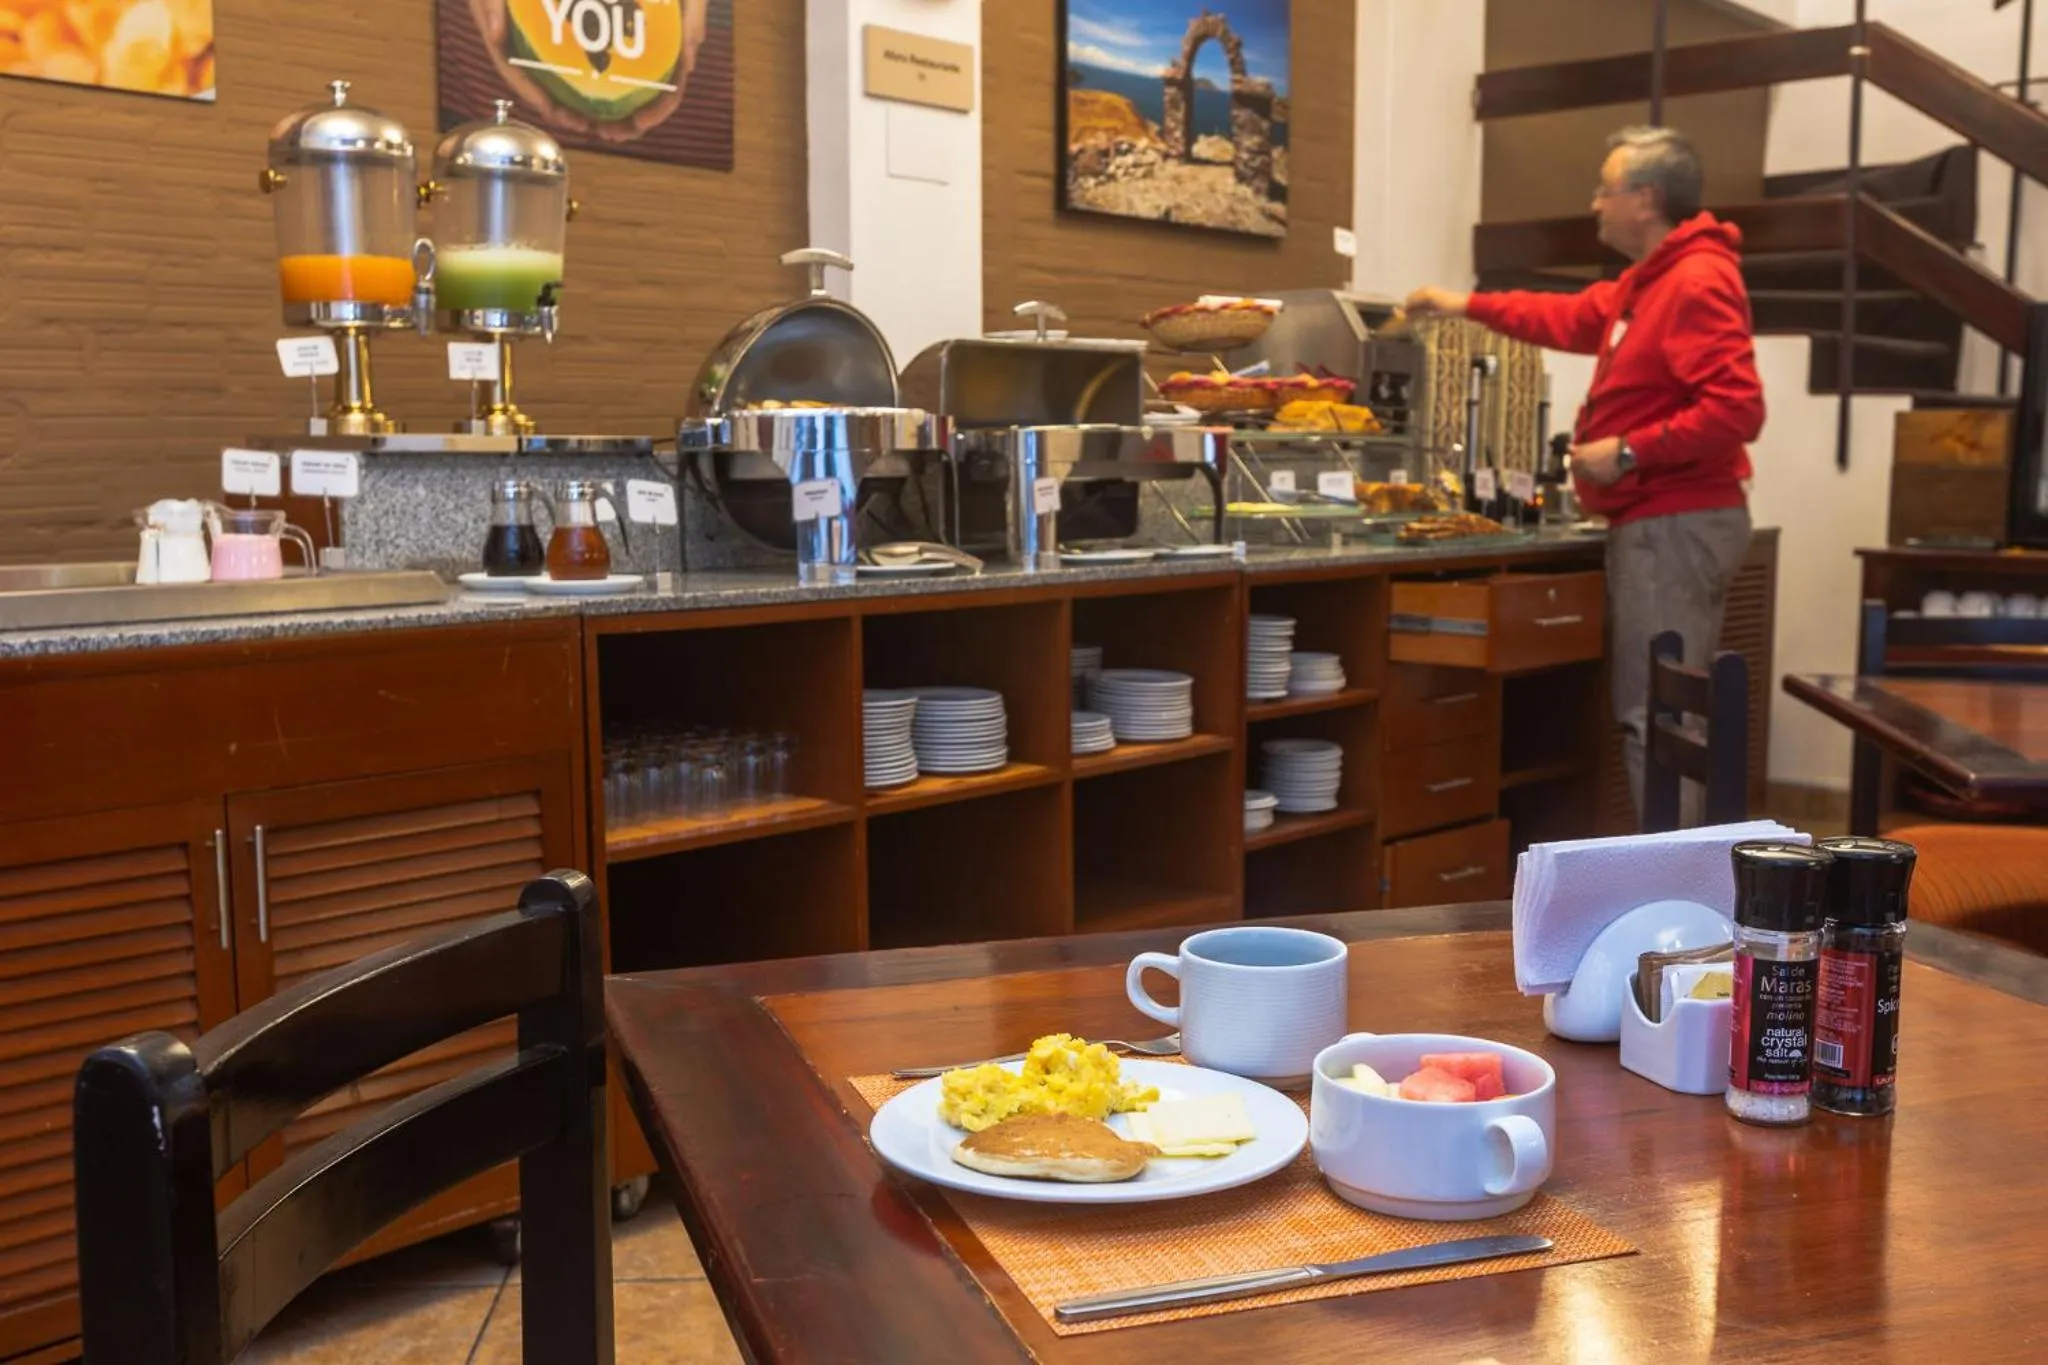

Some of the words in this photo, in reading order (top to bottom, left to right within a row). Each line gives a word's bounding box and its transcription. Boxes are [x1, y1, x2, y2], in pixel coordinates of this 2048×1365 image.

[540, 0, 645, 59] YOU
[1790, 965, 1805, 977] de
[1760, 975, 1813, 993] Maras
[1766, 1009, 1805, 1020] molino
[1766, 1026, 1805, 1037] natural
[1760, 1033, 1808, 1050] crystal
[1765, 1047, 1789, 1058] salt
